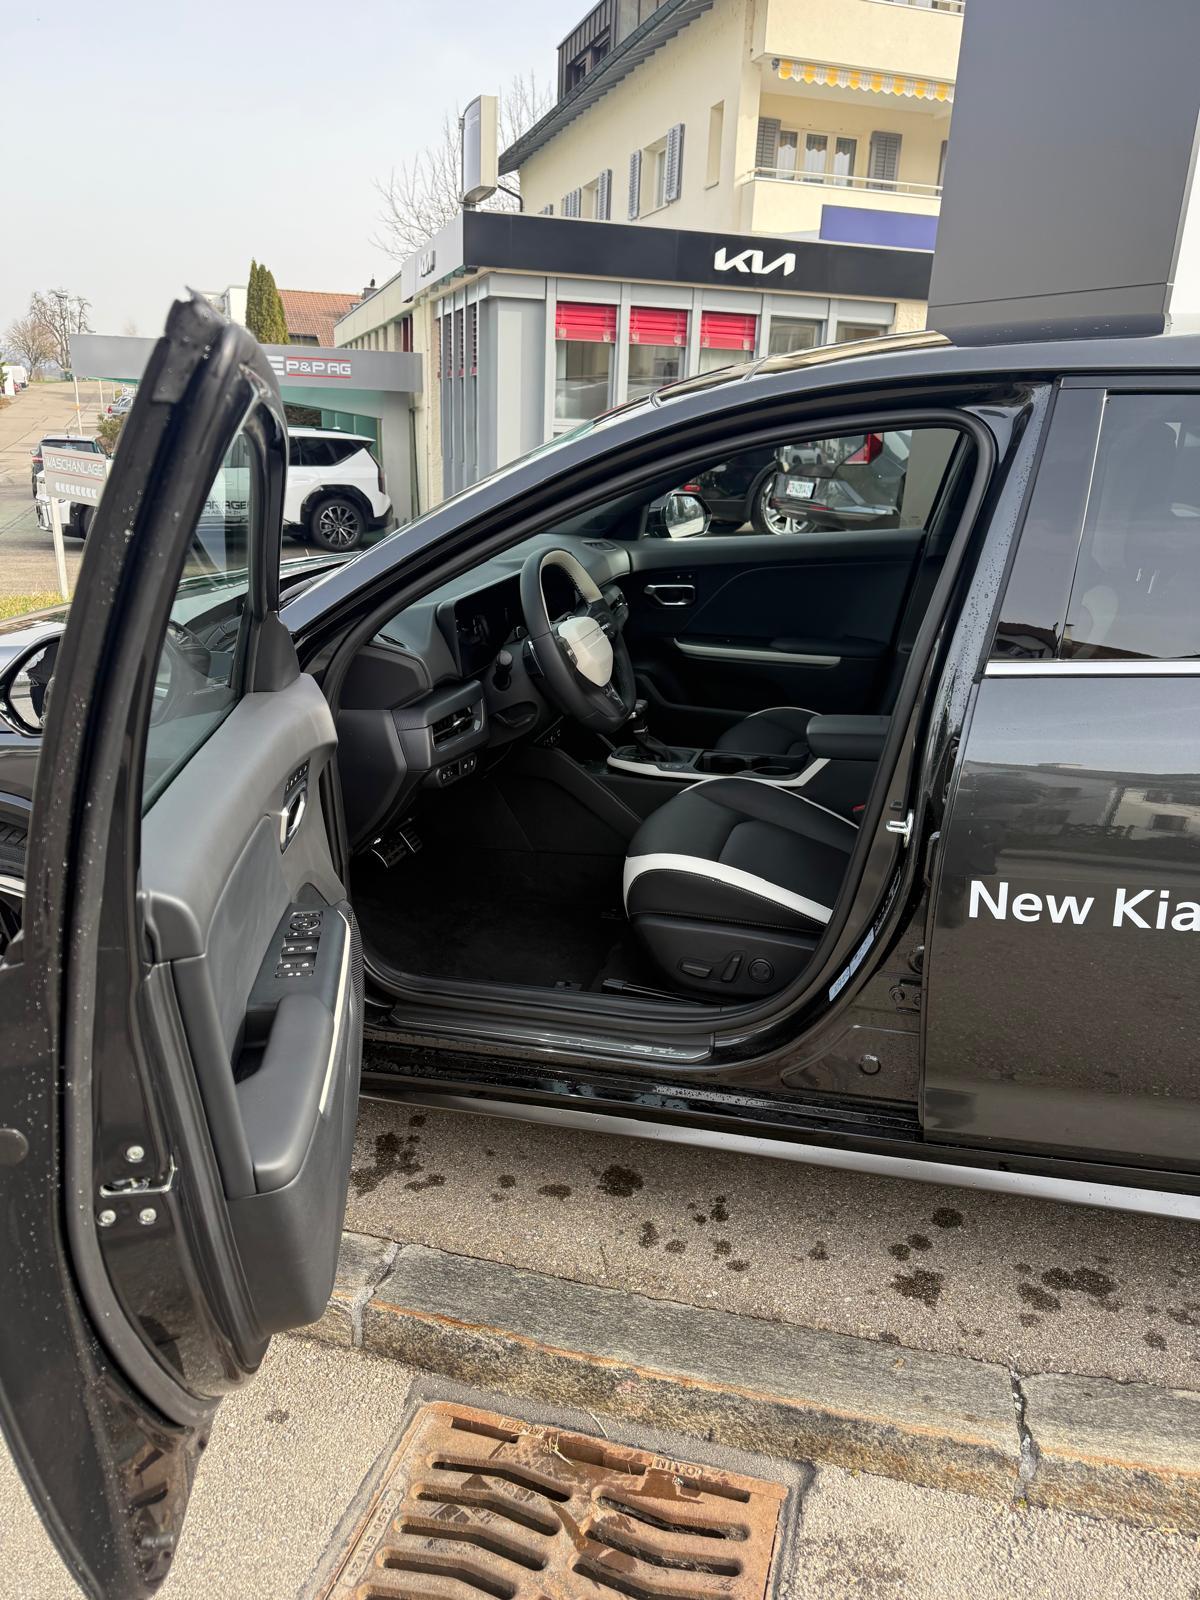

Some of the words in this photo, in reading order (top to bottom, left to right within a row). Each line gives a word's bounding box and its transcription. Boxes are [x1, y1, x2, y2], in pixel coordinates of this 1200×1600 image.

[714, 247, 796, 276] KIA
[286, 360, 325, 373] P&P
[327, 362, 352, 375] AG
[968, 880, 1095, 925] New
[1112, 888, 1200, 932] Kia
